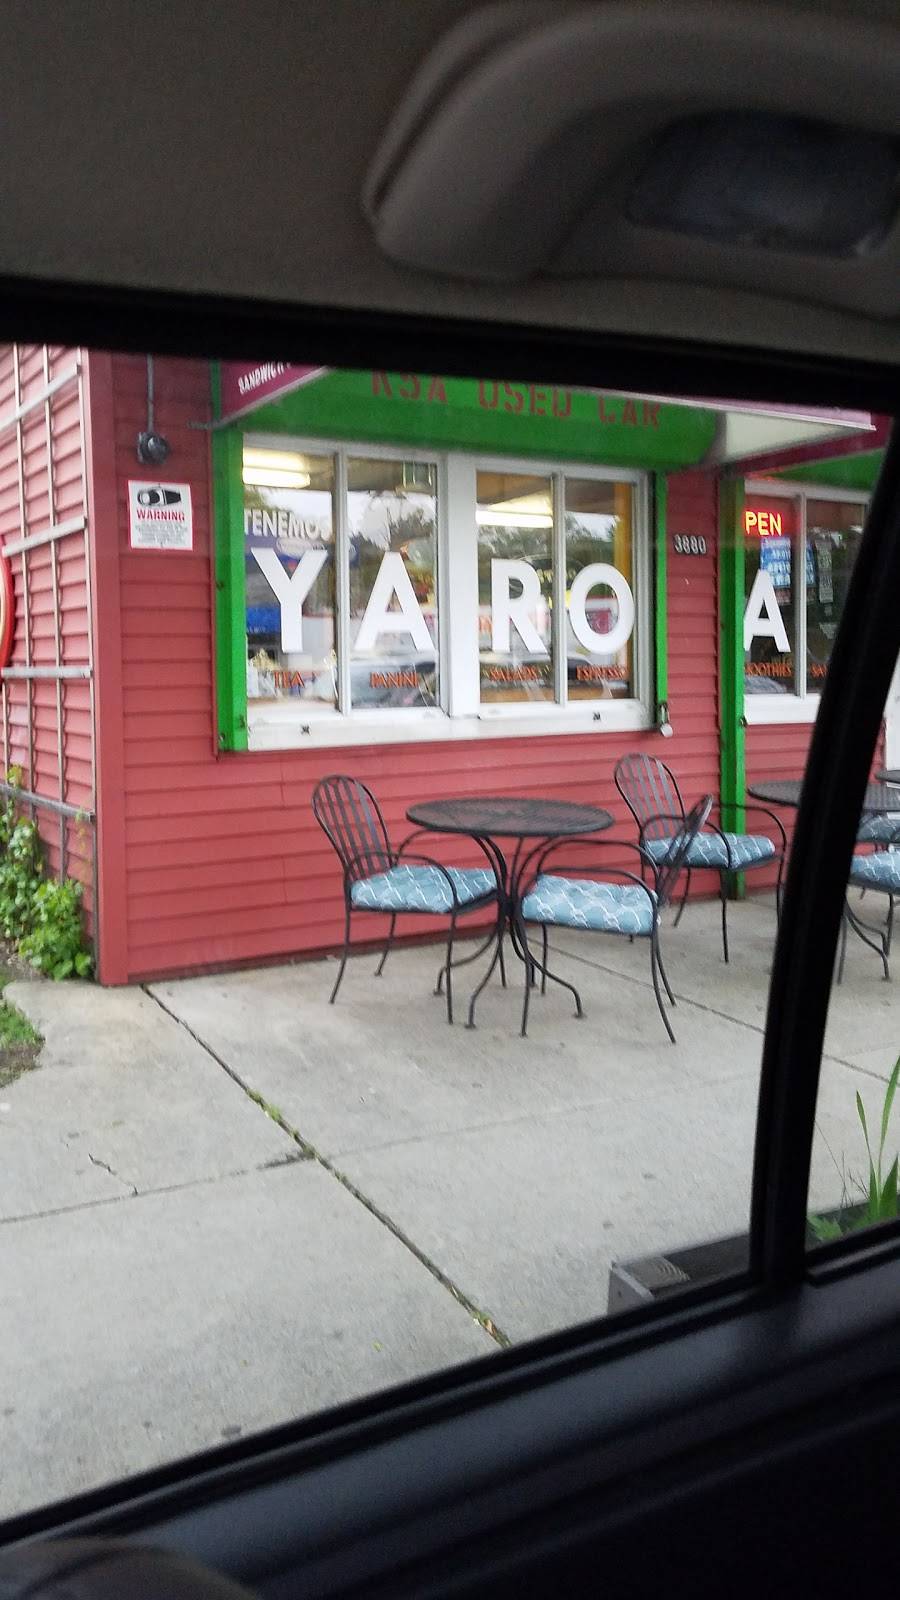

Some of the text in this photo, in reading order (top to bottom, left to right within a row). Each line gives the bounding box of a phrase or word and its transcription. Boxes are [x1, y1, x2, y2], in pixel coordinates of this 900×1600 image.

[136, 509, 185, 522] WARNING
[744, 510, 783, 537] PEN
[674, 534, 707, 555] 3880
[273, 671, 306, 689] TEA
